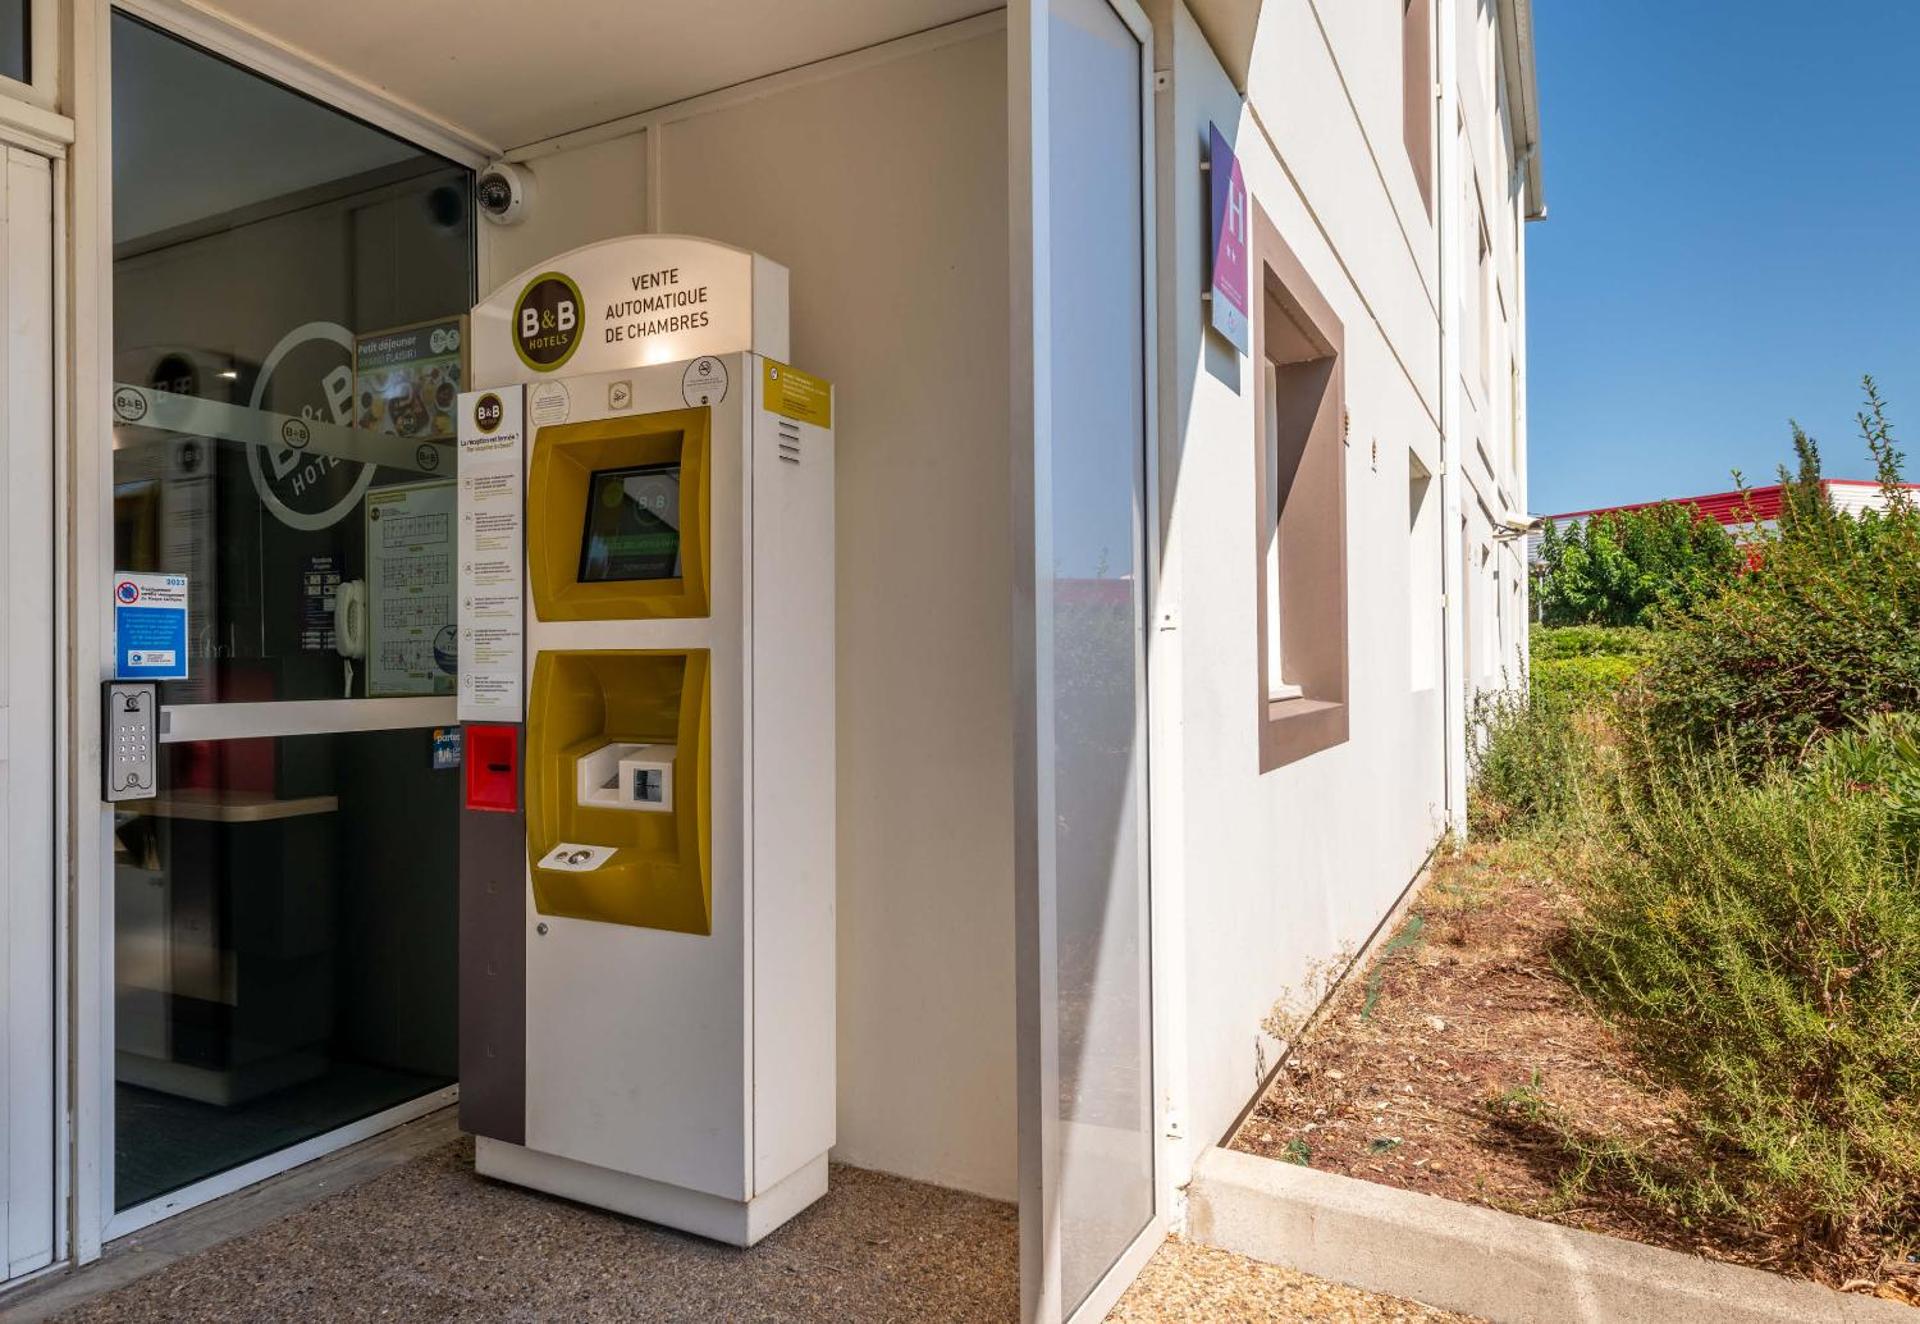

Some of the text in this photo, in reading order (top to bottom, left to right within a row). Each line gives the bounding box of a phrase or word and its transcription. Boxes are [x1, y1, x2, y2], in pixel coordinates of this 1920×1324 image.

[1228, 177, 1245, 246] H
[631, 268, 679, 291] VENTE
[522, 300, 576, 338] B&B
[605, 286, 708, 320] AUTOMATIQUE
[529, 333, 568, 350] HOTELS
[605, 311, 709, 343] DE CHAMBRES
[478, 405, 500, 420] B&B
